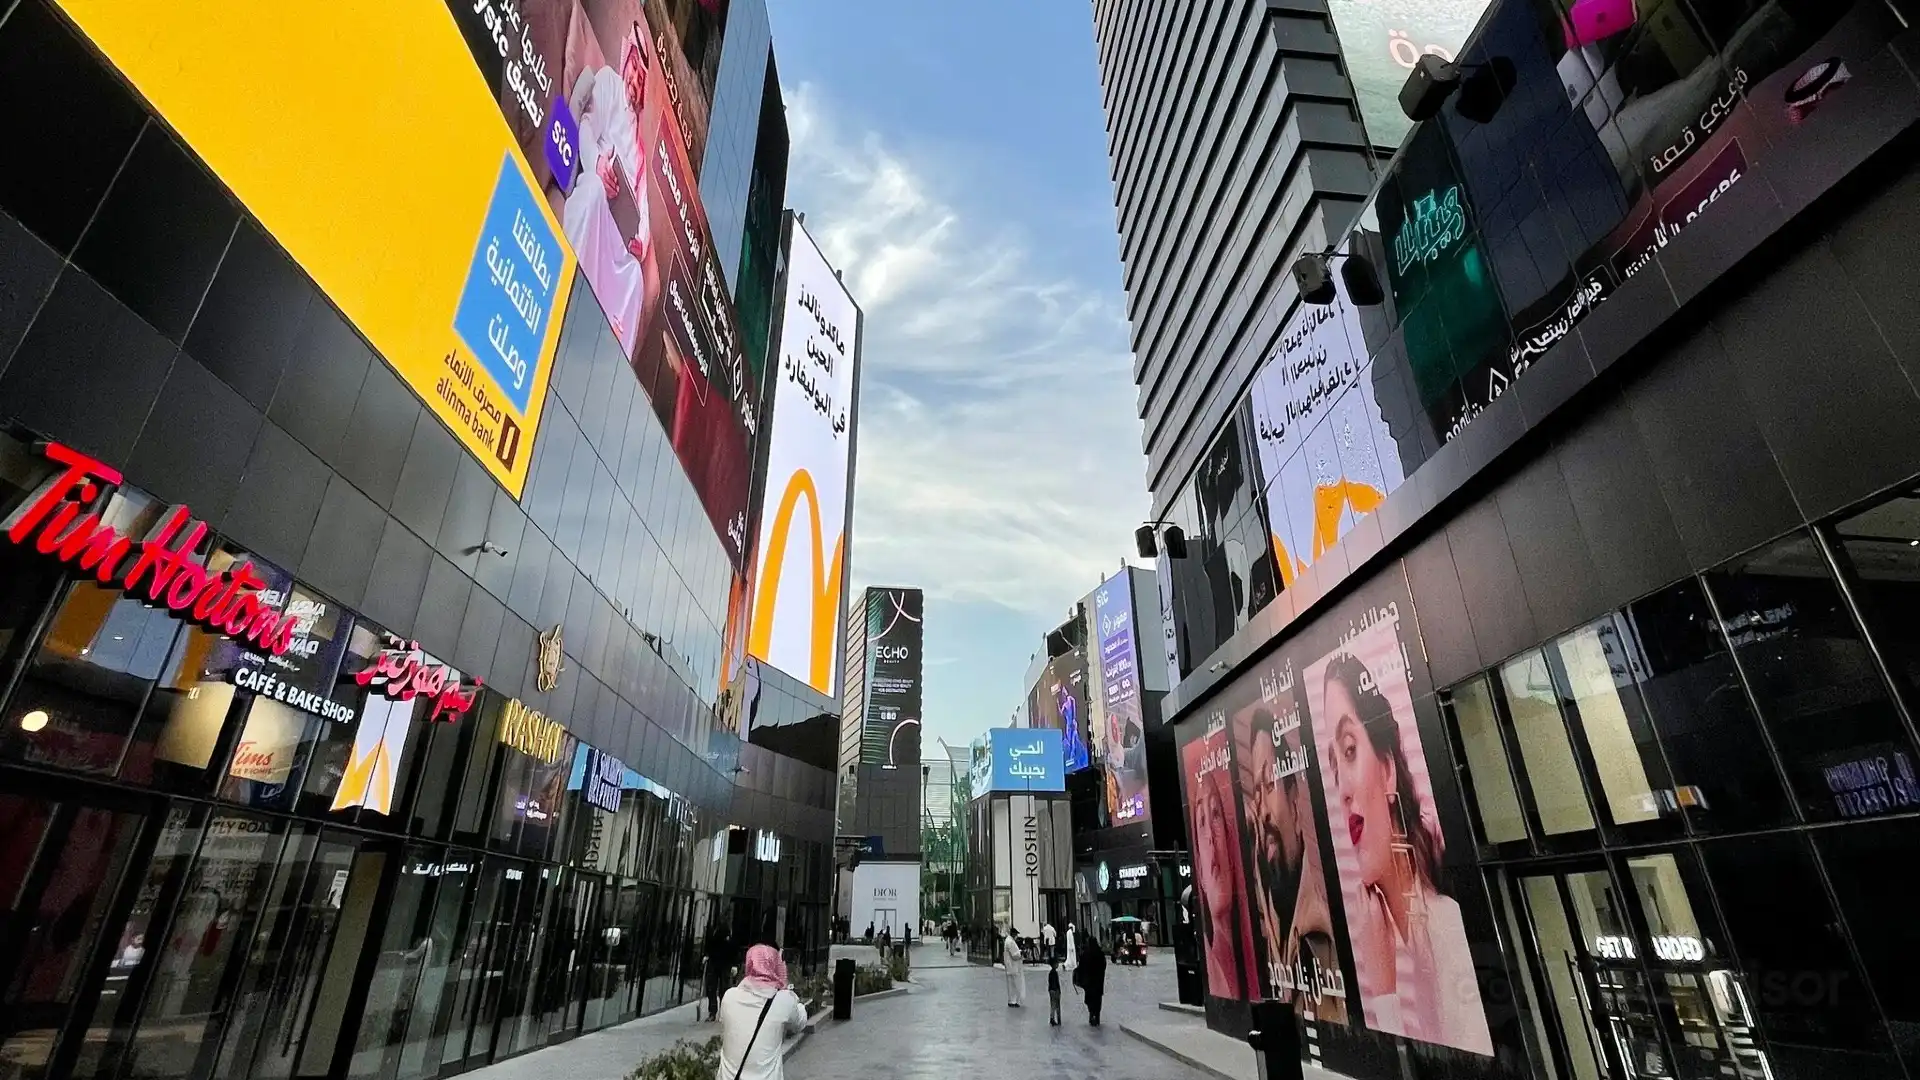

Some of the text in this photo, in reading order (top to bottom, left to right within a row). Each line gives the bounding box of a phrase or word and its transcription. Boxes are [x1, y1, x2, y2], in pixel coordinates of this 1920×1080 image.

[521, 23, 552, 98] اطلبها
[506, 60, 544, 128] تطبيق
[551, 119, 573, 167] stc
[512, 207, 552, 296] بطاقتنا
[798, 284, 845, 357] ماكدونالدز
[488, 313, 528, 391] وصلت
[807, 334, 834, 379] الحين
[436, 376, 496, 453] alinma bank
[472, 382, 502, 424] مصرف
[785, 353, 846, 440] في البوليفارد
[9, 441, 131, 581] Tim
[124, 504, 298, 655] Hortons
[875, 646, 909, 659] ECHO
[234, 667, 355, 724] CAFÉ & BAKE SHOP
[1009, 740, 1044, 758] الحي
[1024, 815, 1038, 877] ROSHN
[1119, 865, 1148, 879] STARBUCKS
[873, 887, 897, 897] DIOR
[1596, 936, 1622, 959] GET
